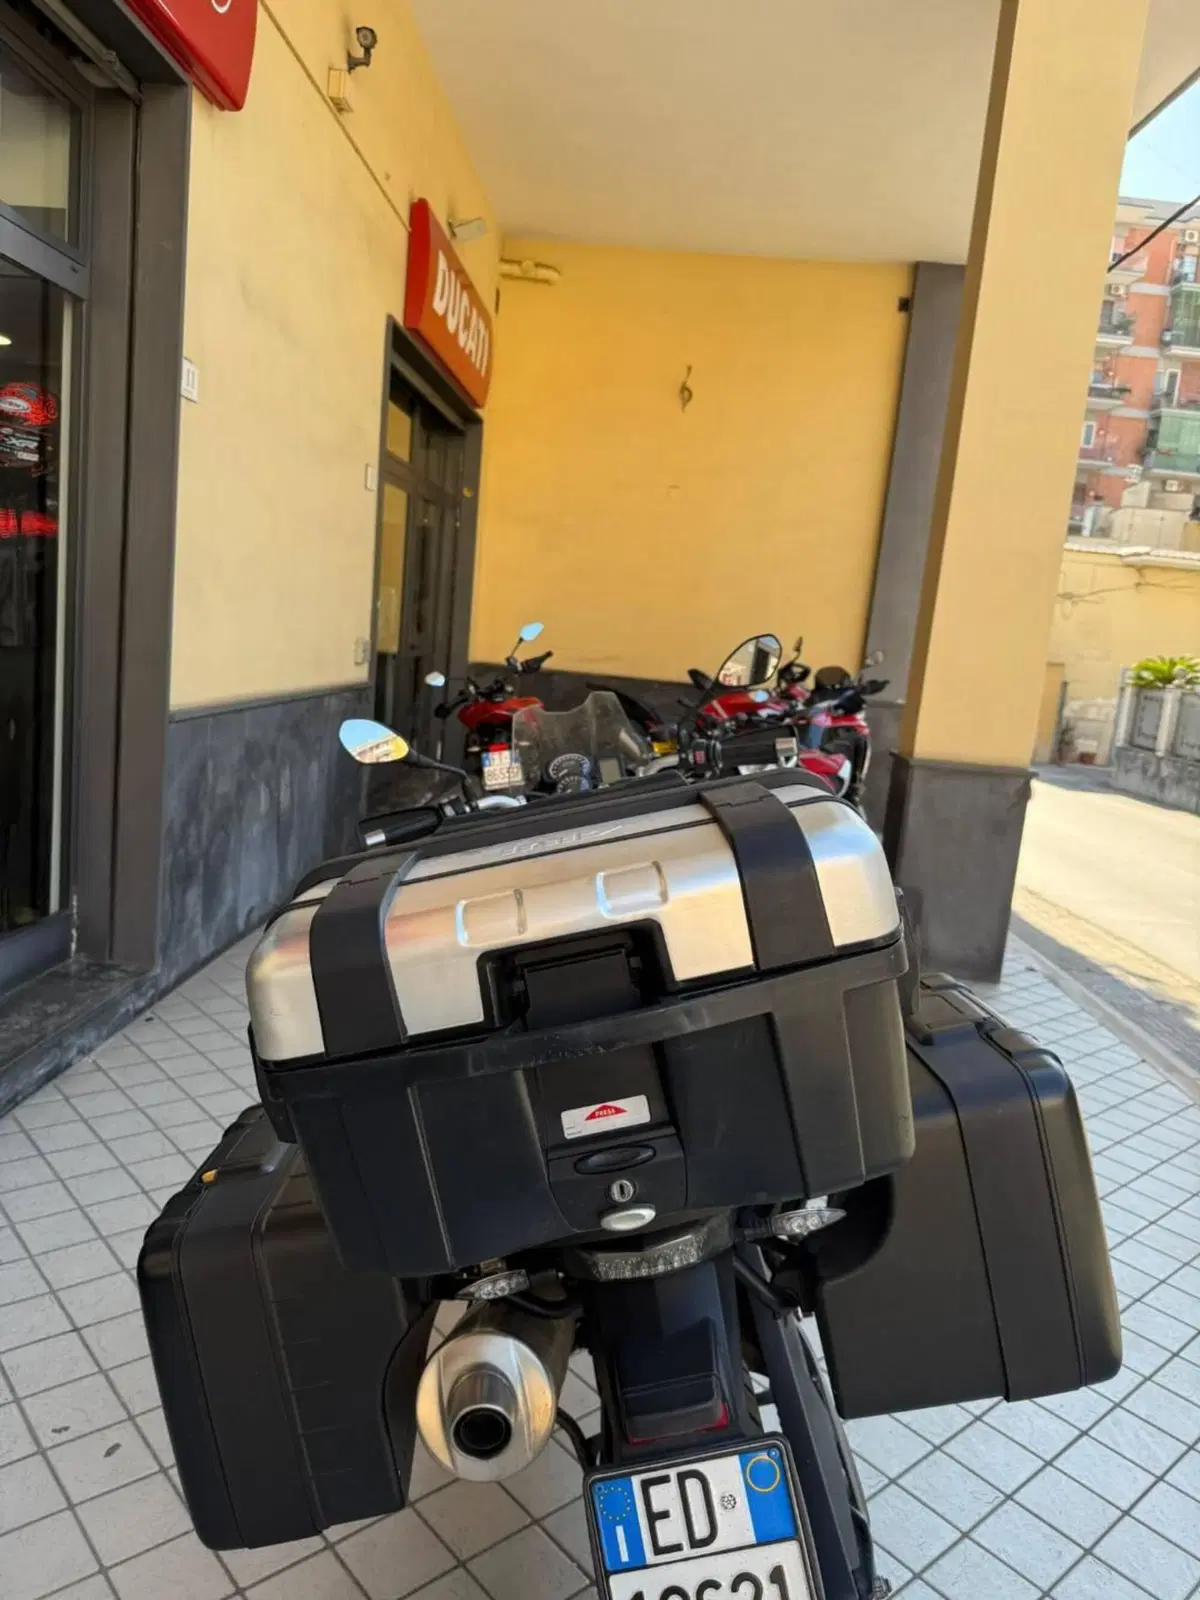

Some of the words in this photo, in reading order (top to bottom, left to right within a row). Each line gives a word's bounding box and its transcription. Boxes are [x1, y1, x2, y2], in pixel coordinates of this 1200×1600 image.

[432, 249, 489, 377] DUCATI
[594, 1108, 616, 1117] PRESS
[640, 1468, 718, 1557] ED
